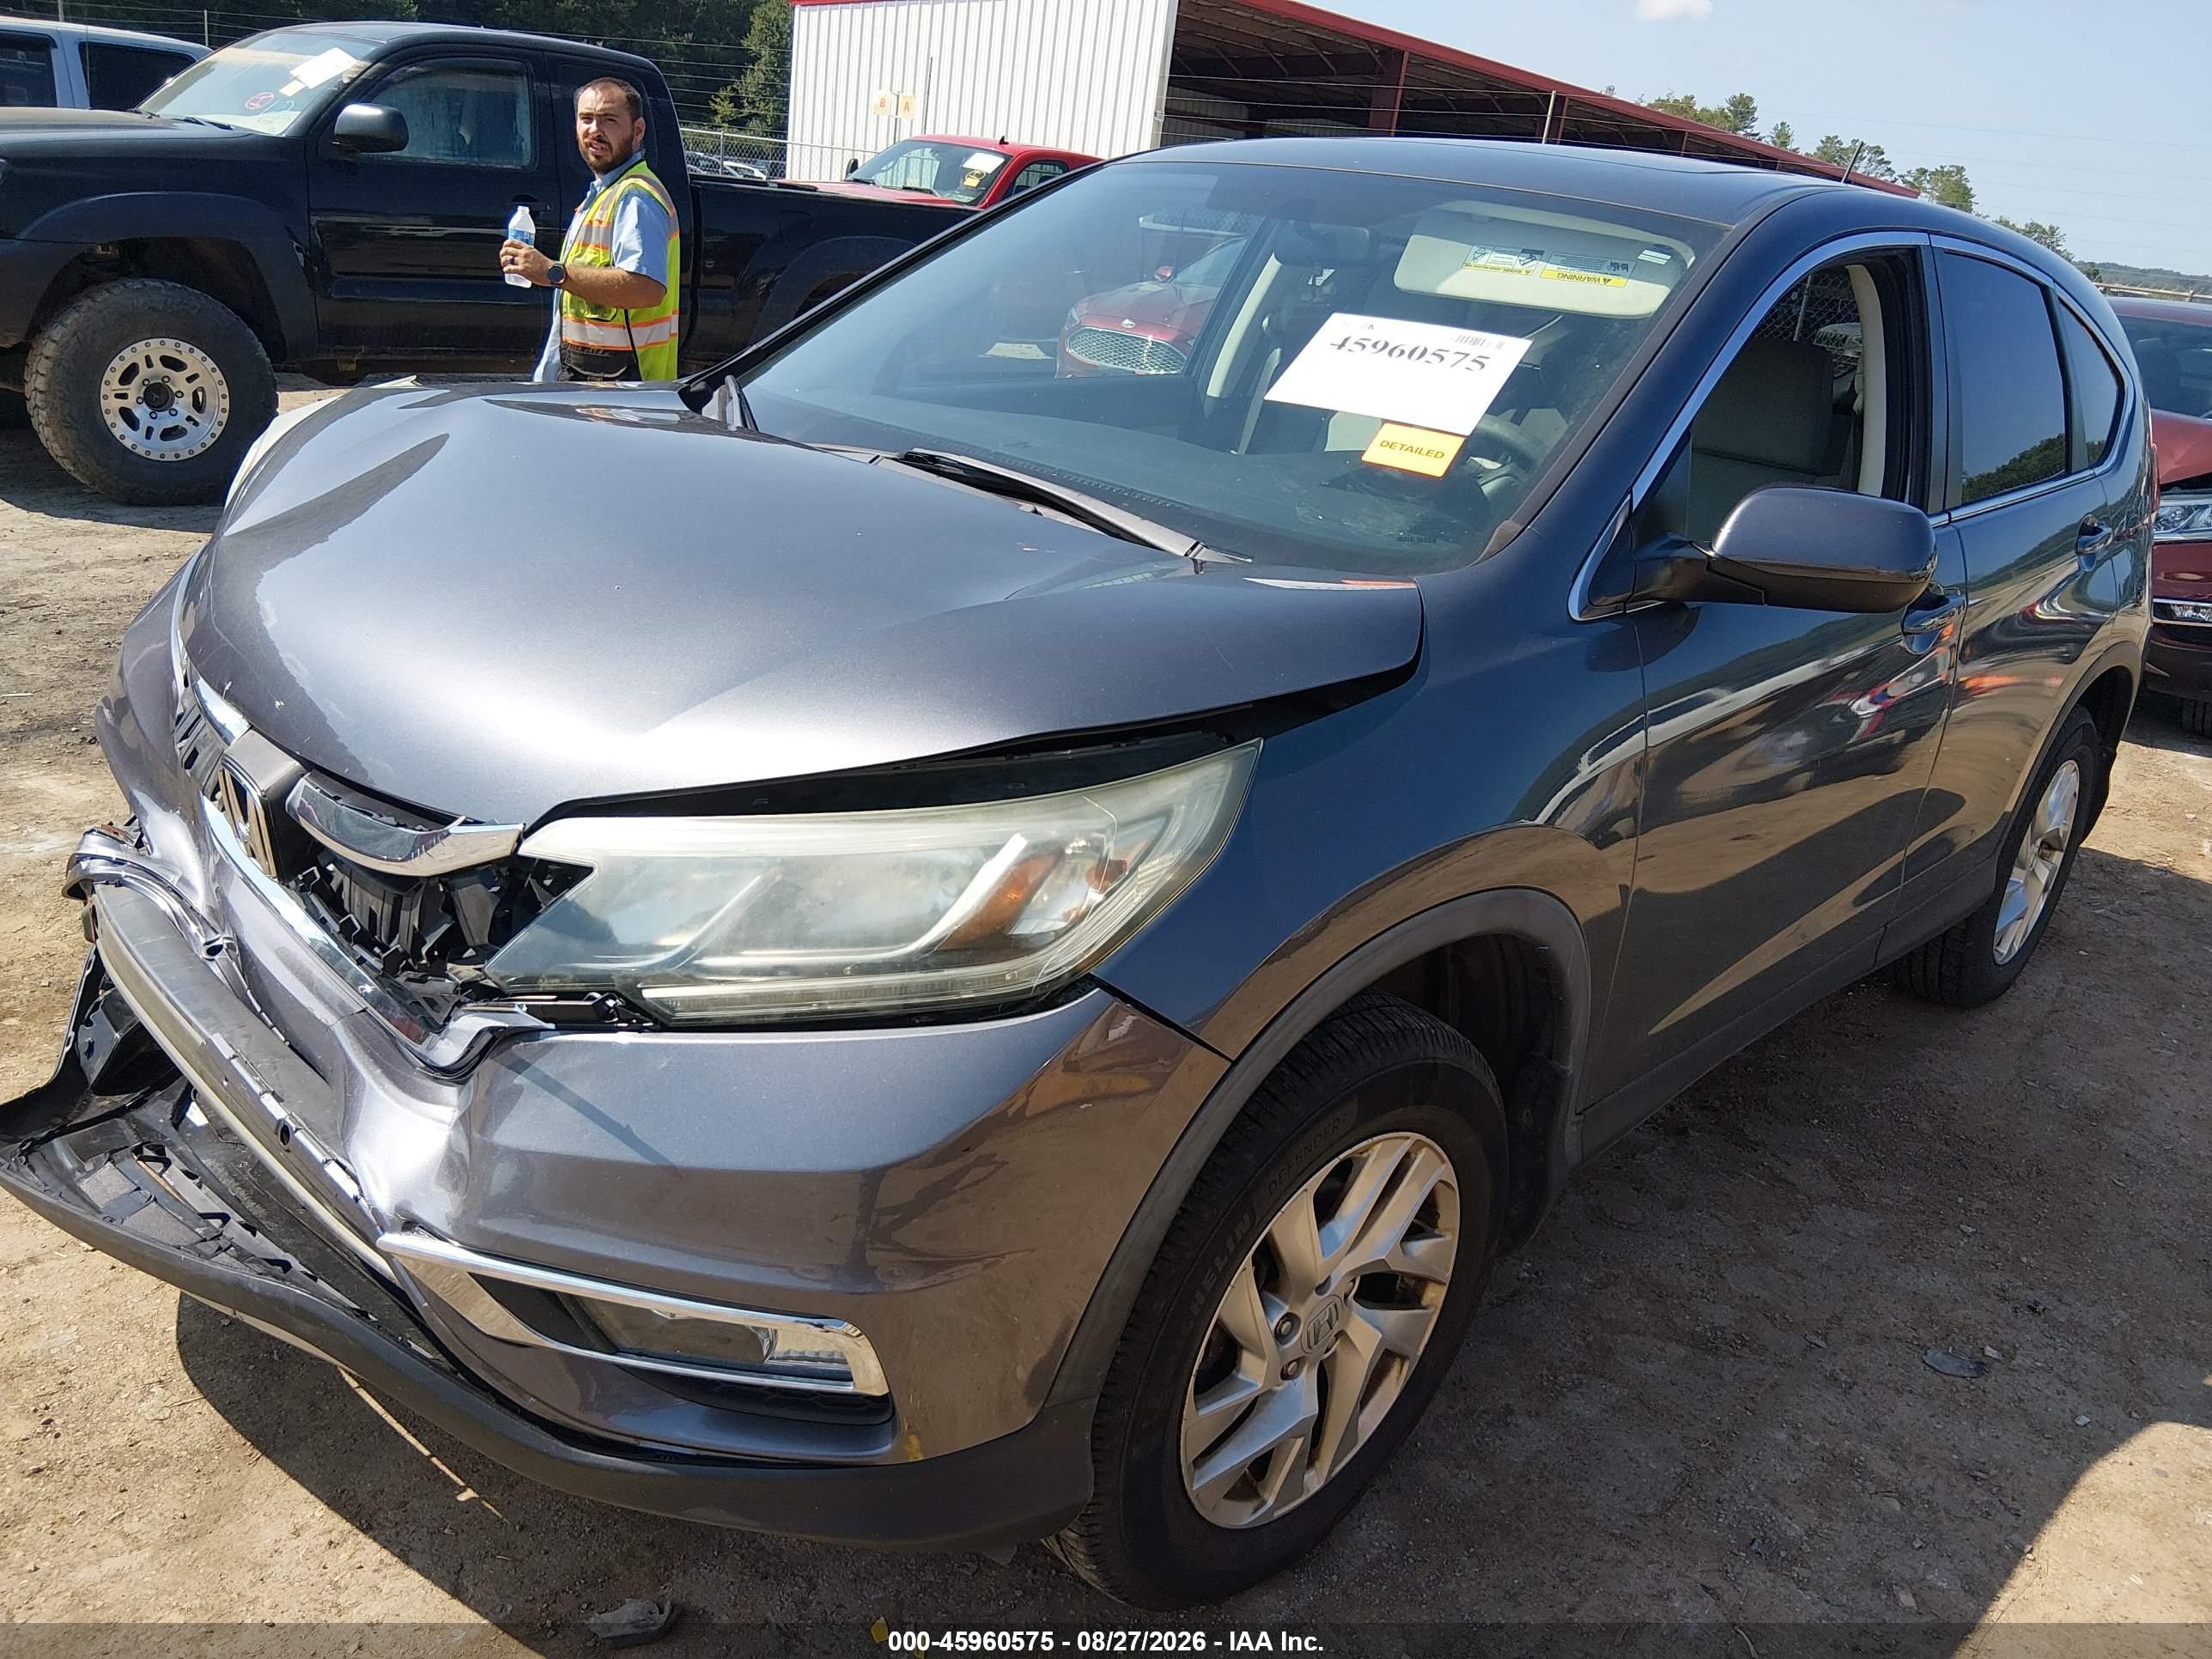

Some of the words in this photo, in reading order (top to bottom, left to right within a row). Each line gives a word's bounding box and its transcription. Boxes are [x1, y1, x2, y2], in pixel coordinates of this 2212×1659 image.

[879, 98, 886, 108] B
[903, 100, 910, 112] A
[1556, 271, 1601, 285] WARNING
[1330, 335, 1492, 372] 45960575
[1380, 440, 1445, 459] DETAILED
